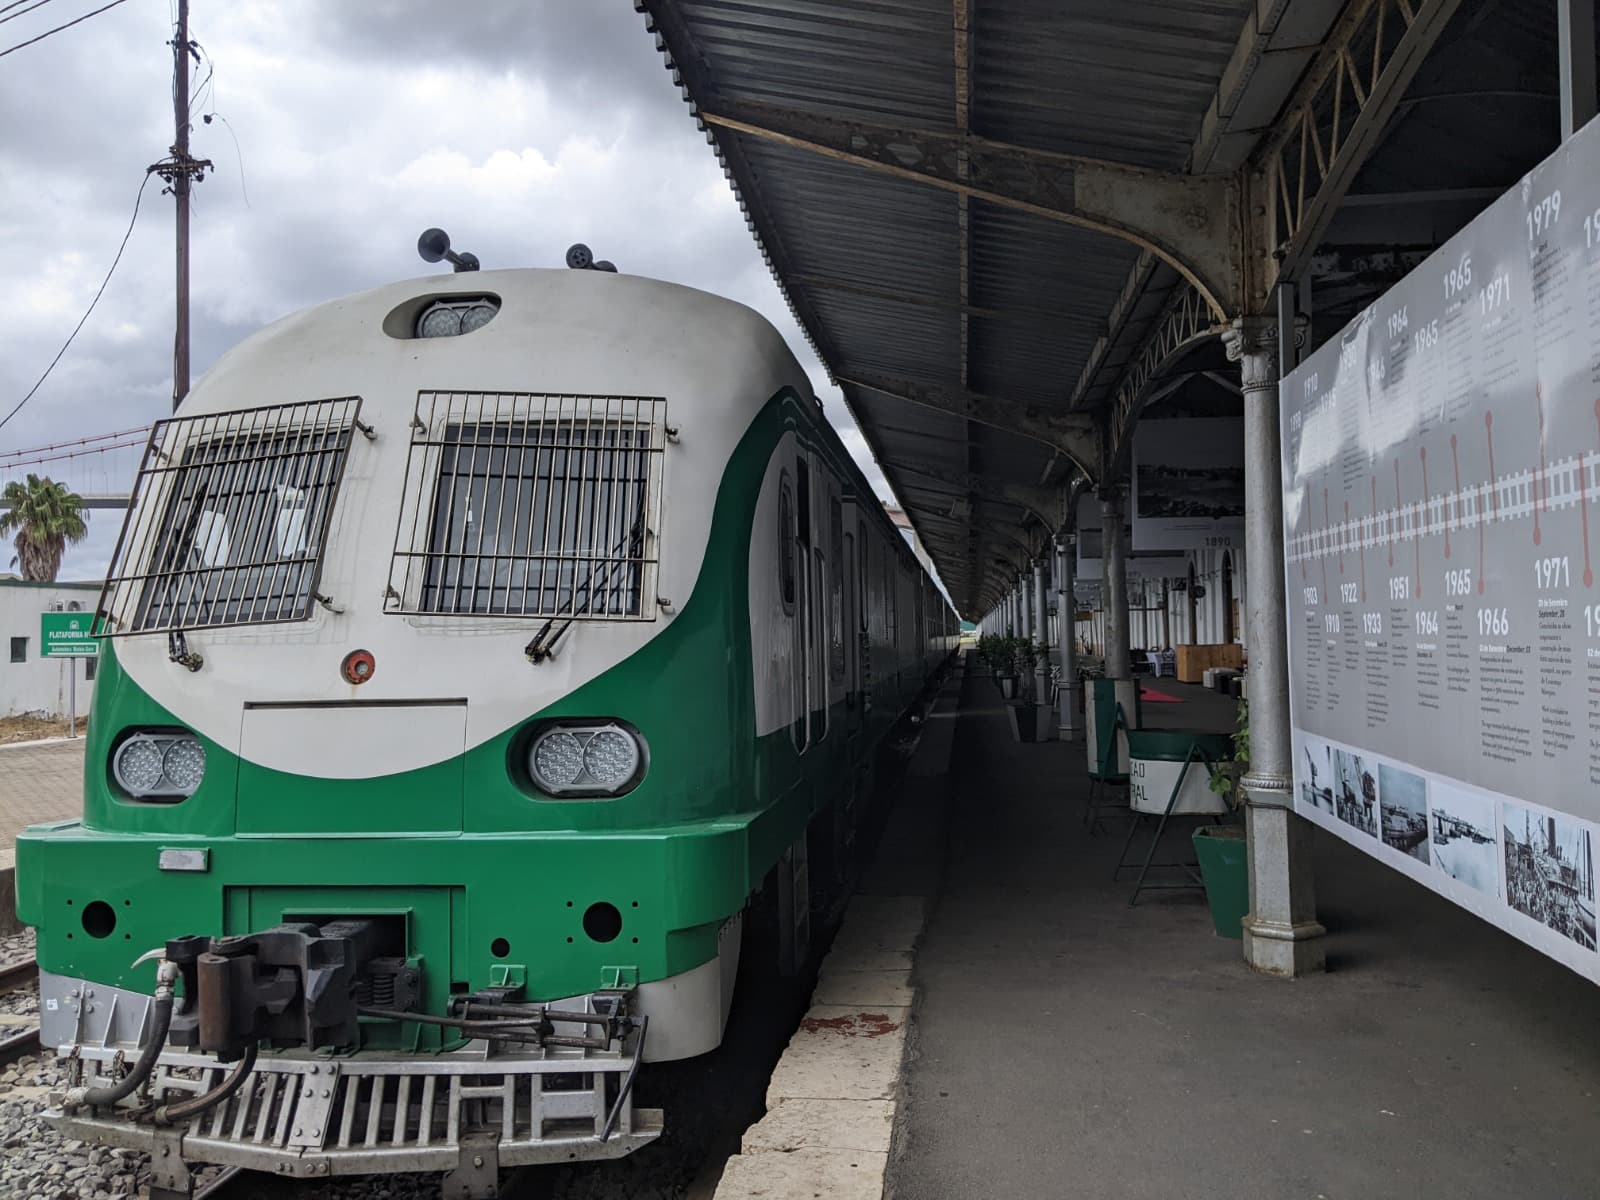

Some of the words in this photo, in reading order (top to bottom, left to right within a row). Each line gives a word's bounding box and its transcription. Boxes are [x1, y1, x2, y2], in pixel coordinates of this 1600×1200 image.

[1526, 189, 1561, 241] 1979
[1443, 258, 1472, 300] 1965
[1479, 273, 1511, 315] 1971
[1387, 306, 1408, 340] 1964
[1414, 319, 1438, 353] 1965
[1205, 536, 1231, 547] 1890
[1445, 568, 1471, 596] 1965
[1534, 556, 1570, 589] 1971
[1303, 586, 1318, 606] 1903
[1340, 582, 1358, 604] 1922
[1389, 576, 1410, 600] 1951
[1324, 613, 1340, 633] 1910
[1362, 612, 1382, 635] 1933
[1415, 610, 1439, 636] 1964
[1477, 607, 1509, 636] 1966
